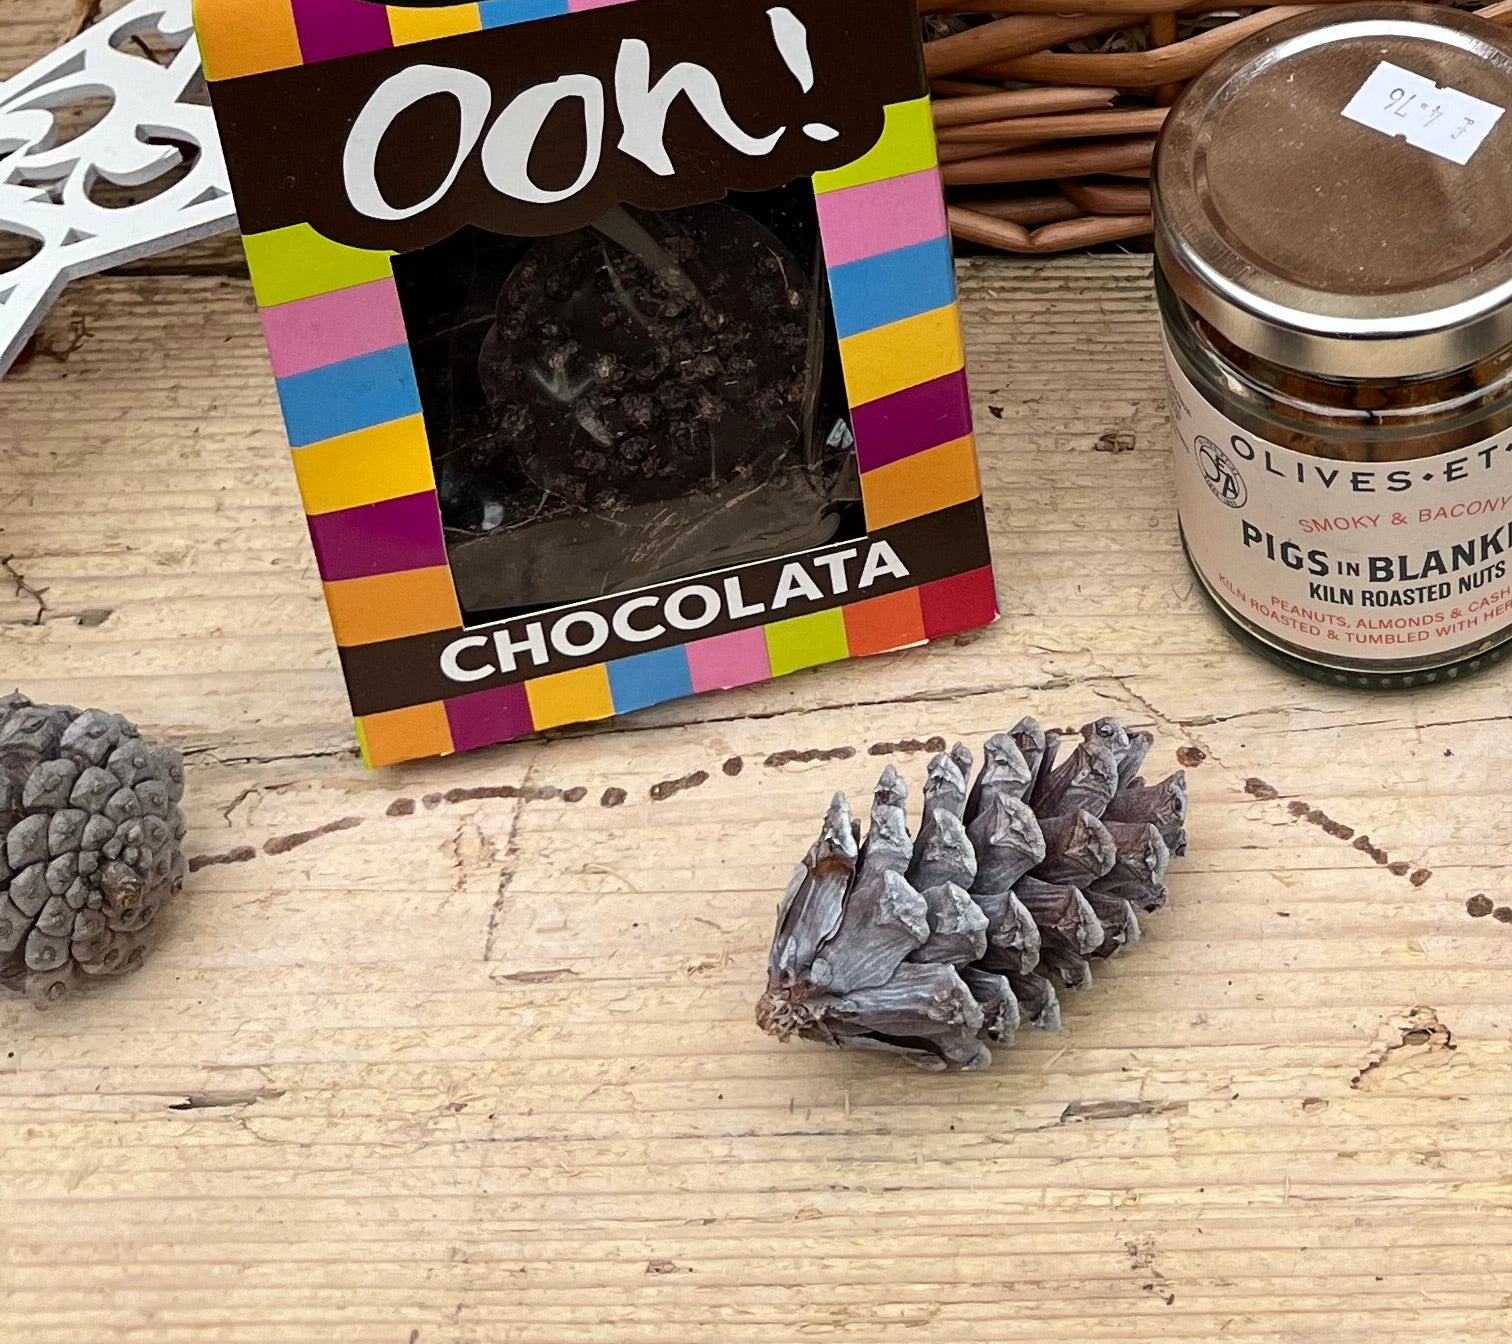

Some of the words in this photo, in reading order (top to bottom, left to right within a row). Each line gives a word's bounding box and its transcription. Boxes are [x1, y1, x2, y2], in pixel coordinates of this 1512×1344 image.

[341, 5, 843, 222] Ooh!
[1230, 434, 1413, 493] OLIVES
[1241, 518, 1330, 578] PIGS
[1337, 560, 1361, 578] IN
[1298, 515, 1380, 535] SMOKY
[1391, 511, 1408, 526] &
[437, 536, 912, 689] CHOCOLATA
[1217, 572, 1247, 605] KILN
[1249, 598, 1322, 638] ROASTED
[1326, 628, 1341, 642] &
[1345, 629, 1430, 646] TUMBLED
[1434, 617, 1479, 639] WITH
[1270, 594, 1352, 630] PEANUTS,
[1356, 611, 1446, 630] ALMONDS
[1449, 606, 1464, 621] &
[1308, 581, 1354, 608] KILN
[1361, 584, 1452, 608] ROASTED
[1458, 559, 1507, 596] NUTS
